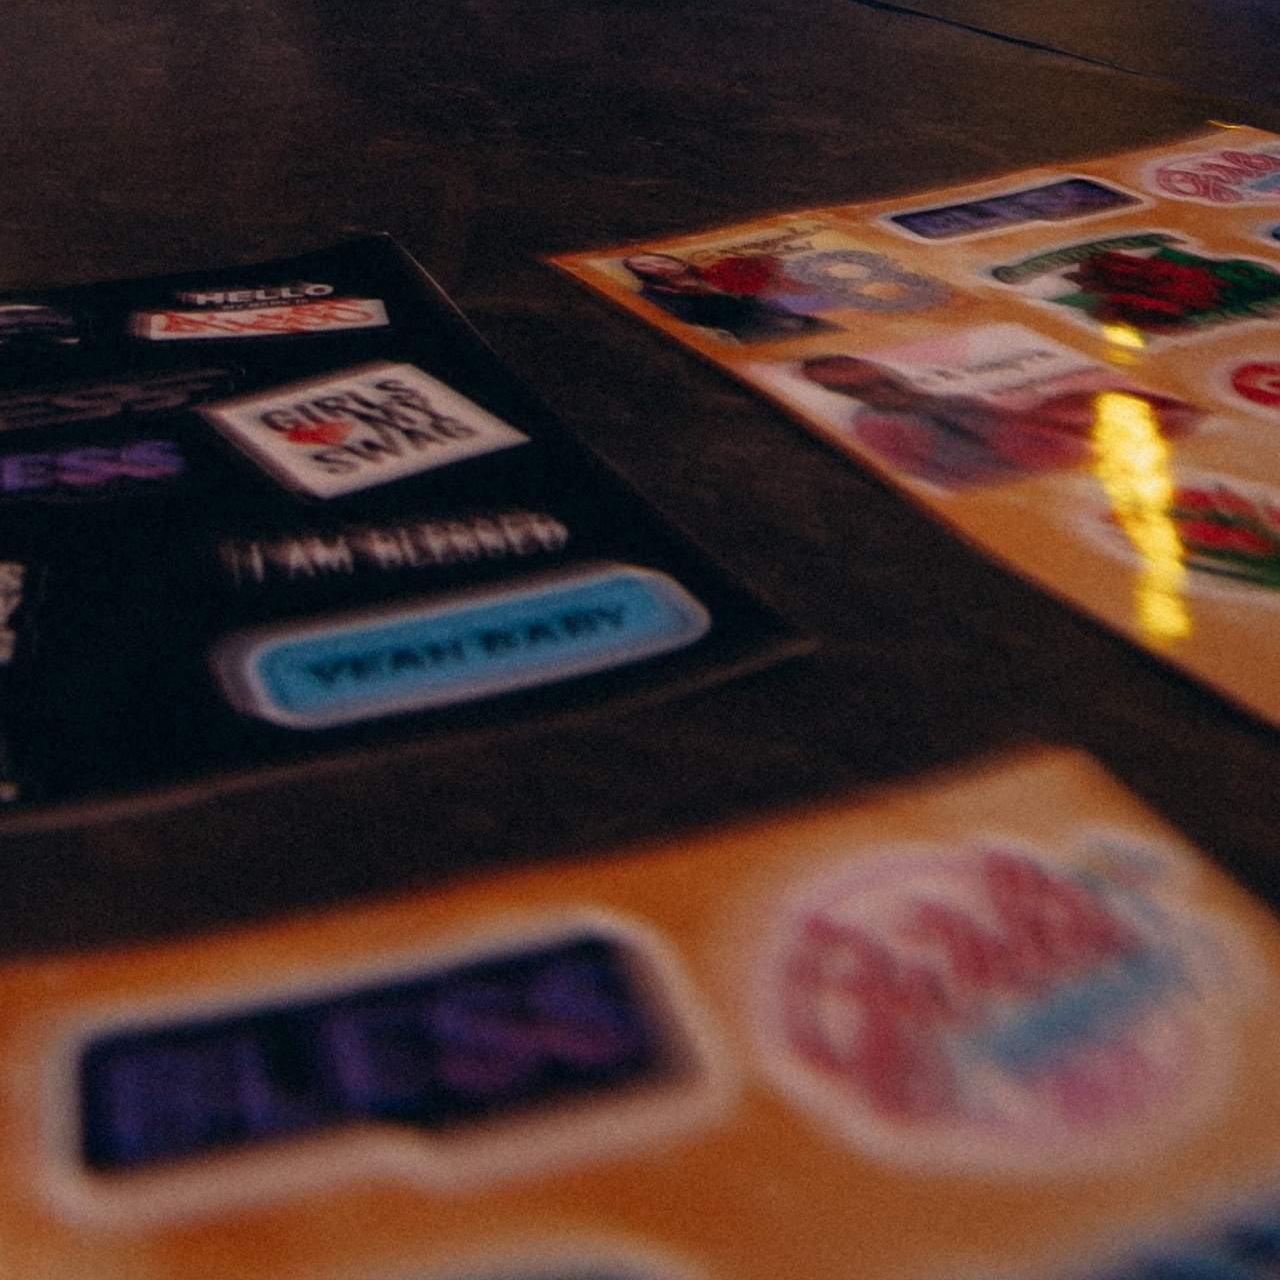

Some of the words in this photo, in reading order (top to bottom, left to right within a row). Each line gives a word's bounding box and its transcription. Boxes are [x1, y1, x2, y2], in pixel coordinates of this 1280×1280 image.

[192, 283, 334, 306] HELLO
[255, 378, 420, 433] GIRLS
[308, 416, 479, 476] SWAG
